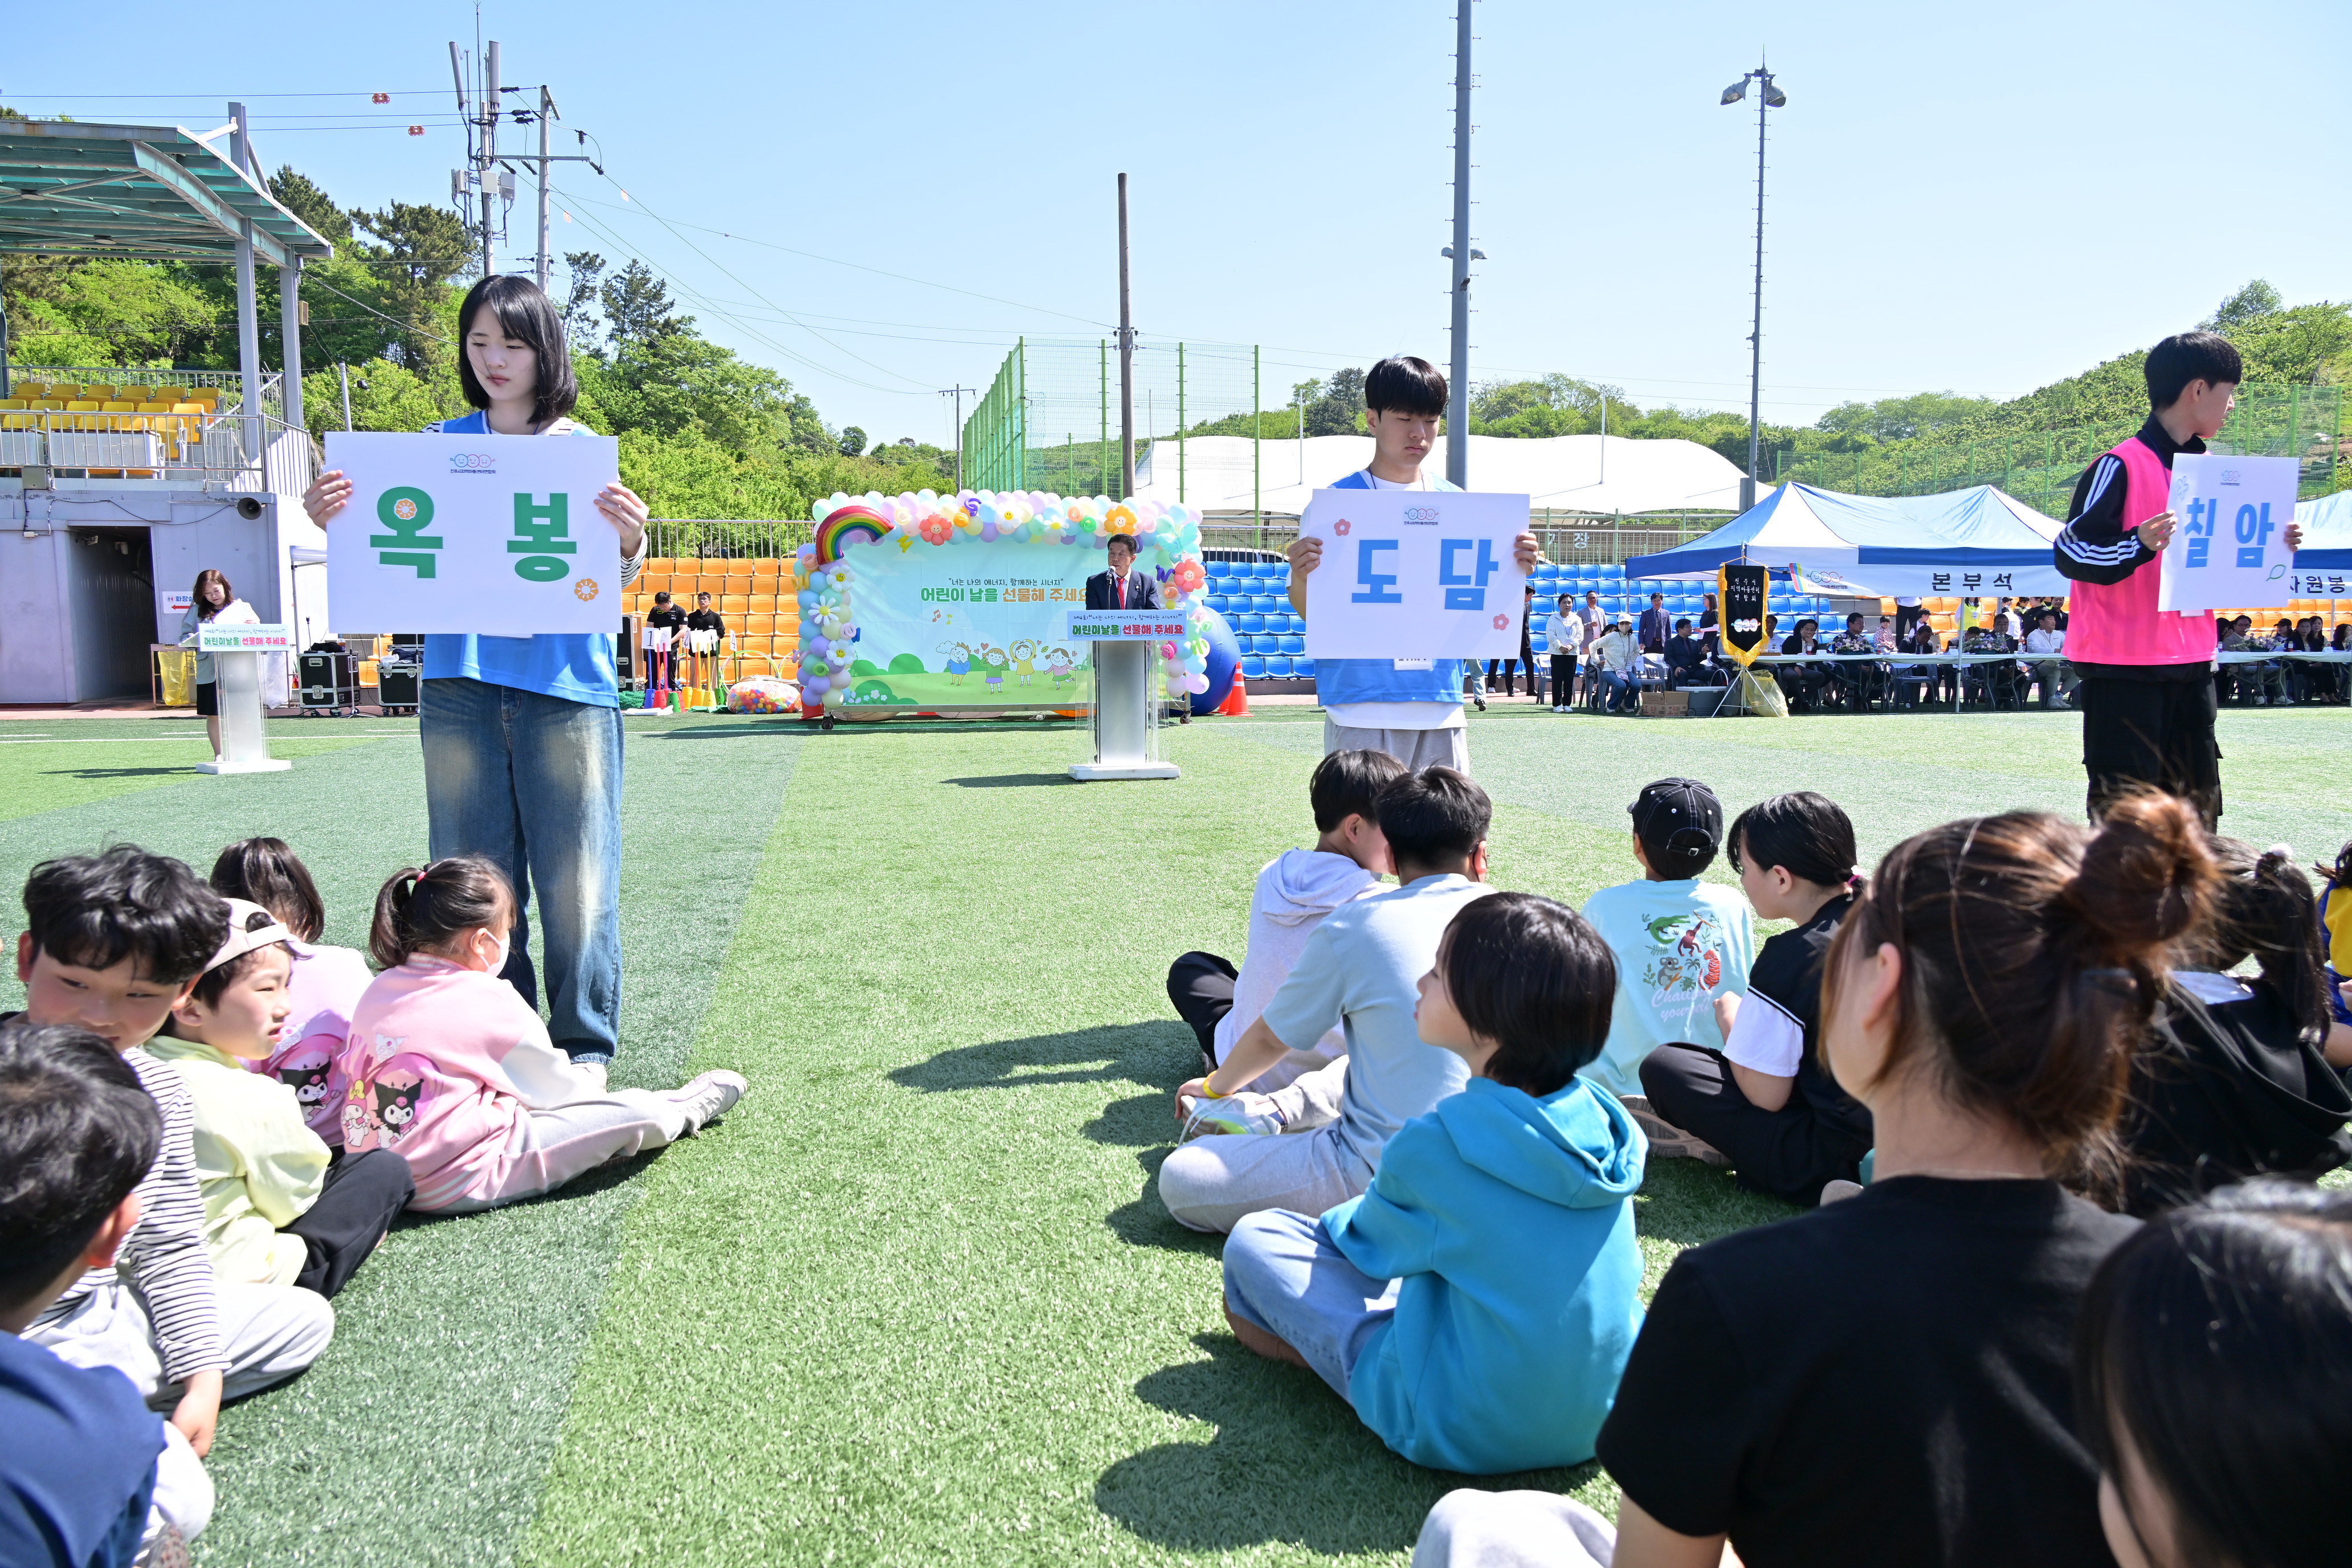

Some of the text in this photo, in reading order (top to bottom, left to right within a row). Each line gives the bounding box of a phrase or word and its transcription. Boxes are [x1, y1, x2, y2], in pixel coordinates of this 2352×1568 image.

[1010, 578, 1038, 586] 함께하는
[921, 587, 965, 602] 어린이
[969, 587, 998, 602] 날을
[1002, 587, 1045, 602] 선물해
[1122, 624, 1152, 635] 선물해
[1154, 624, 1184, 635] 주세요
[242, 636, 263, 646] 선물해
[265, 637, 287, 646] 주세요
[647, 631, 654, 647] 1
